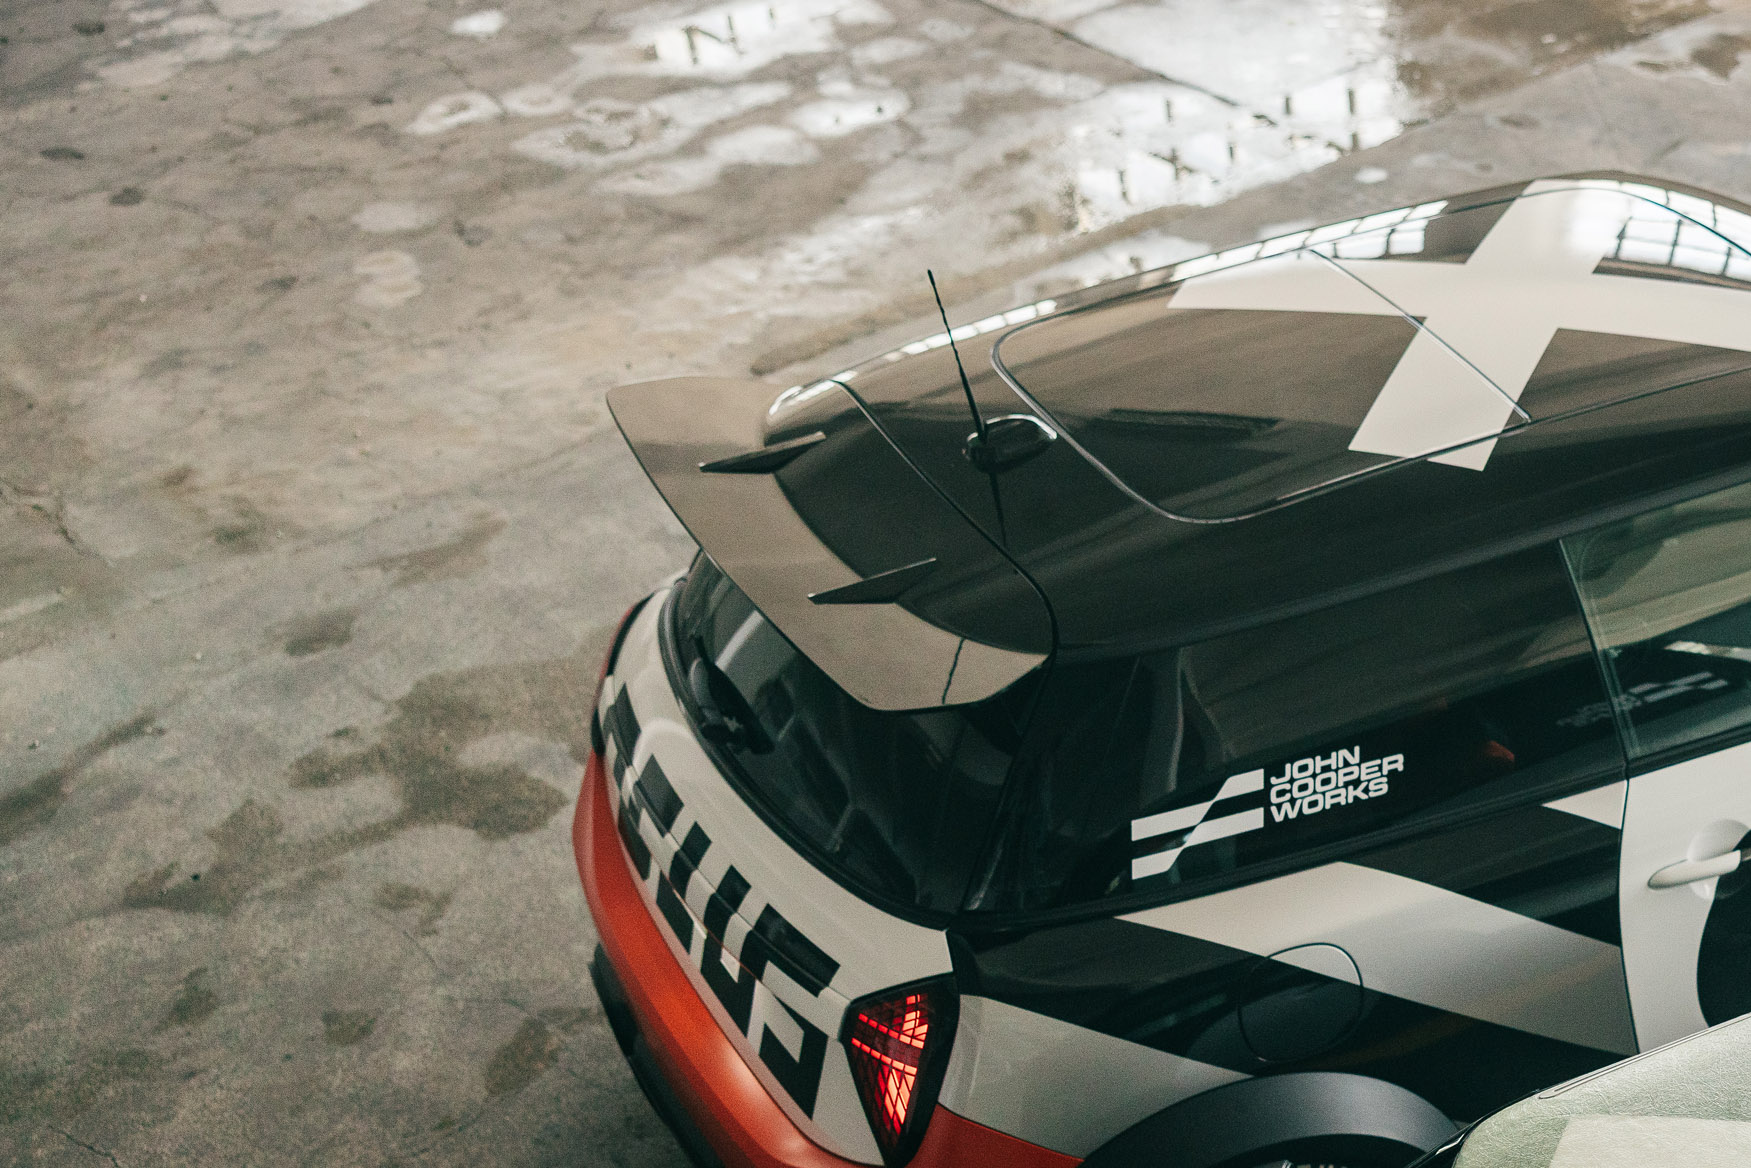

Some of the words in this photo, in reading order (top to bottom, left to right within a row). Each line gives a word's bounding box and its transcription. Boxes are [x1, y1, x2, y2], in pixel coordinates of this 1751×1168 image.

[1270, 745, 1360, 785] JOHN
[1270, 753, 1404, 805] COOPER
[1270, 776, 1389, 823] WORKS
